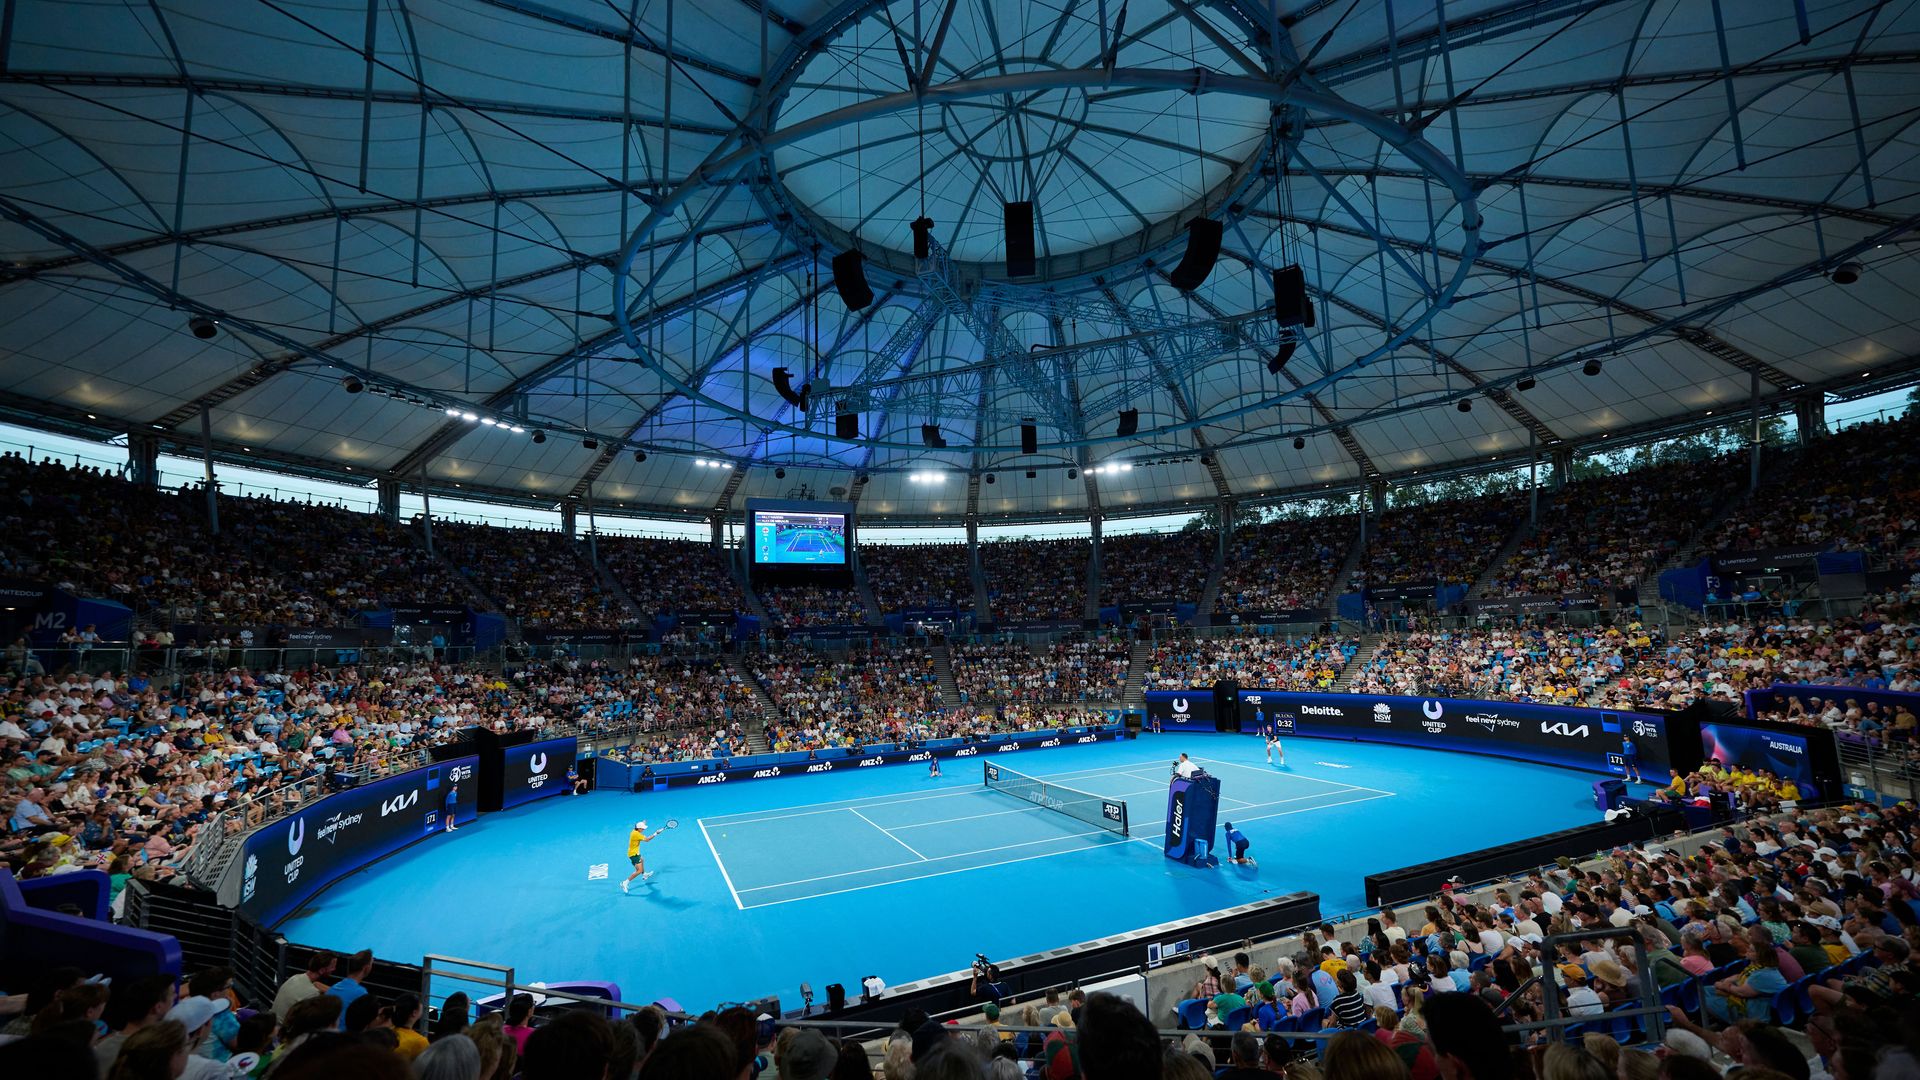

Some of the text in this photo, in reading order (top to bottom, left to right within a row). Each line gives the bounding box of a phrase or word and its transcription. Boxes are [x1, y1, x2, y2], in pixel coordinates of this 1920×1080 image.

[1706, 576, 1720, 588] F3
[35, 612, 66, 630] M2
[461, 622, 471, 634] L2
[1301, 705, 1344, 716] Deloitte.
[1277, 720, 1292, 728] 0:32
[1465, 715, 1480, 723] feel
[1497, 718, 1520, 728] sydney
[1541, 721, 1590, 738] KIA
[1040, 740, 1054, 748] ANZ
[1078, 736, 1091, 744] ANZ
[955, 749, 970, 757] ANZ
[1769, 741, 1803, 754] AUSTRALIA
[859, 758, 875, 767] ANZ
[908, 754, 924, 762] ANZ
[1610, 755, 1624, 765] 171
[753, 770, 771, 778] ANZ
[807, 764, 824, 773] ANZ
[528, 773, 548, 784] UNITED
[697, 775, 717, 784] ANZ
[531, 780, 543, 789] CUP
[381, 789, 418, 817] KIA
[1029, 791, 1064, 811] ATP TOUR
[1104, 804, 1119, 815] ATP
[338, 813, 363, 830] sydney
[426, 814, 436, 824] 171
[1172, 799, 1183, 838] Haier
[284, 855, 304, 875] UNITED
[287, 868, 299, 884] CUP
